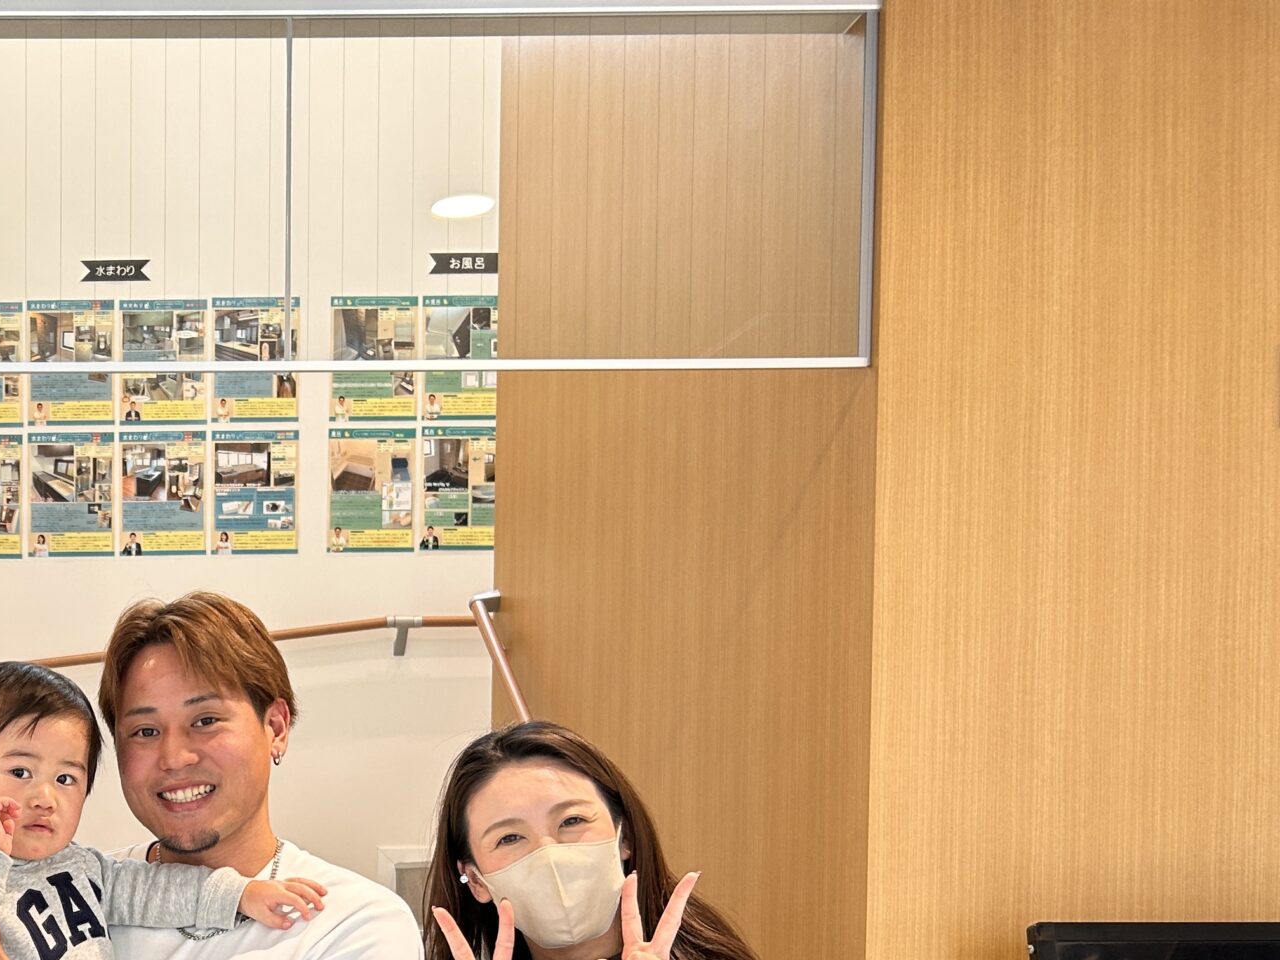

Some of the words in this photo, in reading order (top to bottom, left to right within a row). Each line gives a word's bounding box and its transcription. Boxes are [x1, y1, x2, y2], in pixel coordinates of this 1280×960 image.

[449, 257, 485, 270] お風呂
[95, 265, 135, 276] 水まわり
